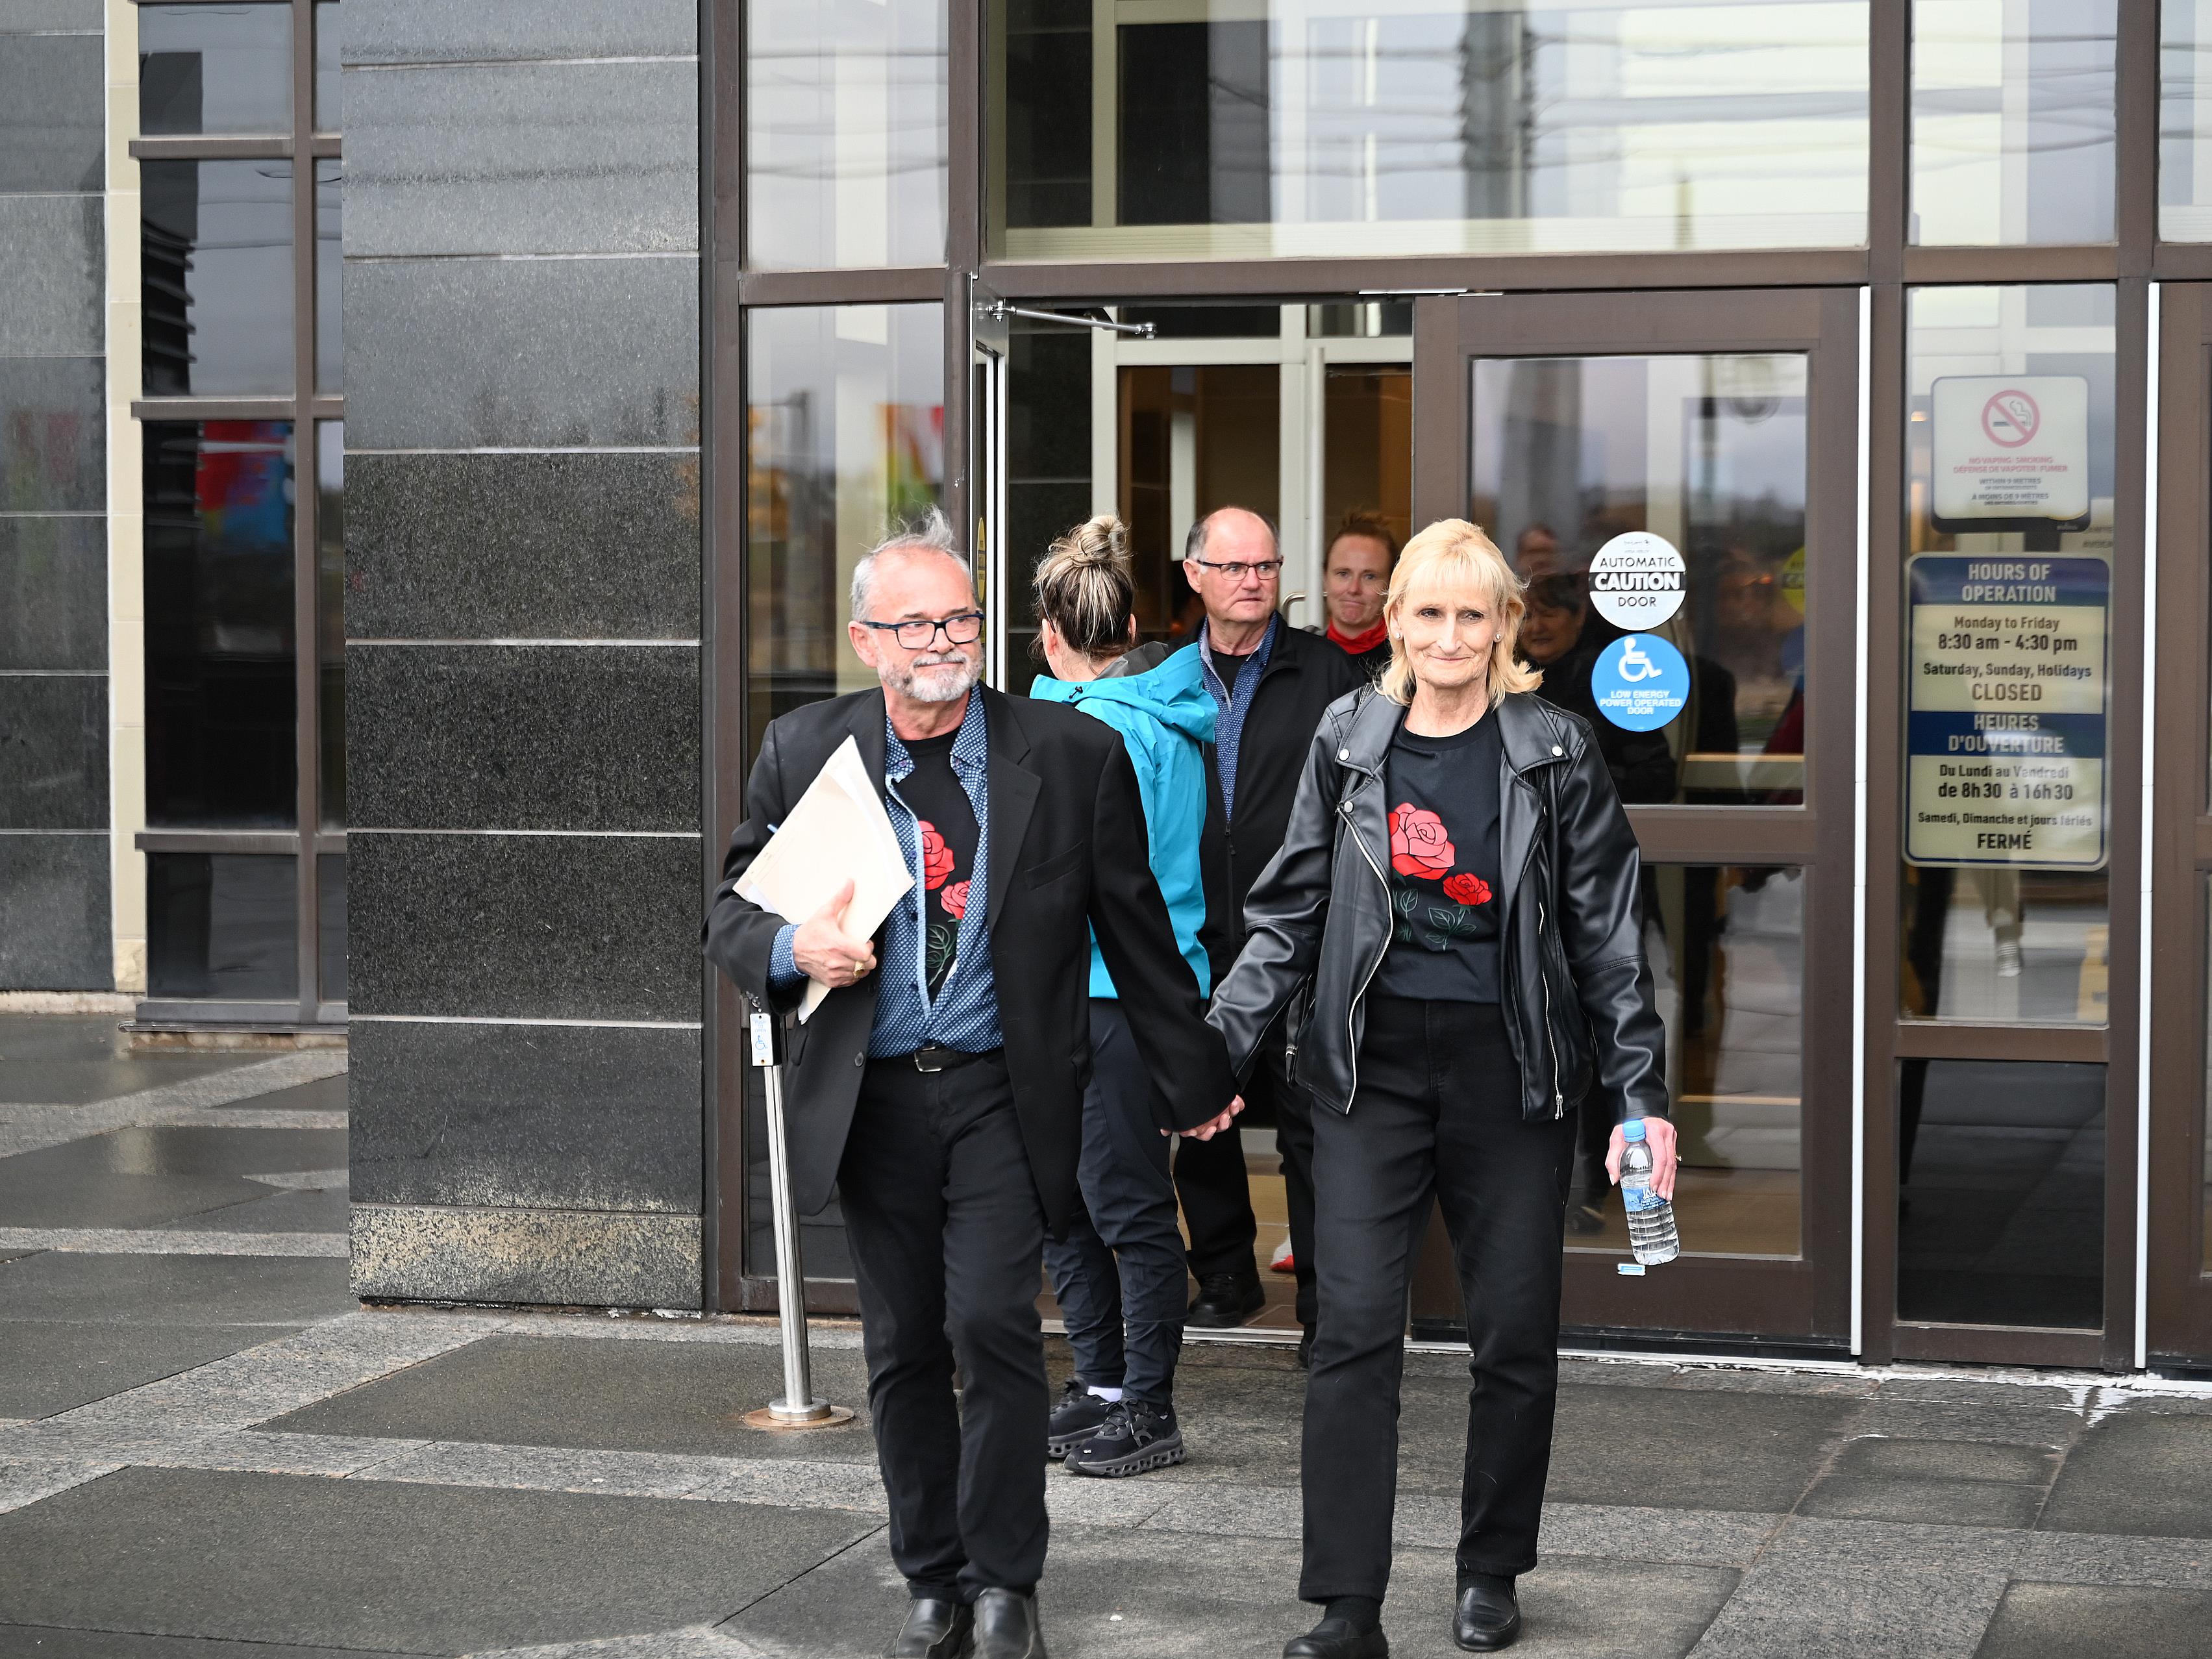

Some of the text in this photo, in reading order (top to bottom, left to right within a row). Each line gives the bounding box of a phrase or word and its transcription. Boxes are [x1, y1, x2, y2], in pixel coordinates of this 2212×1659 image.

[1600, 557, 1675, 567] AUTOMATIC
[1969, 564, 2051, 581] HOURS OF
[1595, 572, 1680, 591] CAUTION
[1618, 597, 1656, 606] DOOR
[1961, 585, 2057, 603] OPERATION
[1954, 616, 2060, 632] Monday to Friday
[1938, 634, 1972, 650] 8:30
[1975, 638, 2000, 650] am
[2015, 634, 2049, 650] 4:30
[2053, 638, 2078, 655] pm
[1923, 662, 2092, 680] Saturday, Sunday, Holidays
[1632, 690, 1671, 699] ENERGY
[1972, 683, 2042, 702] CLOSED
[1627, 706, 1654, 715] DOOR
[1634, 699, 1682, 707] OPERATED
[1973, 714, 2039, 731] HEURES
[1948, 735, 2065, 754] D'OUVERTURE
[1939, 764, 2069, 779] Du Lundi au Vendredi
[1938, 782, 1957, 797] de
[2009, 783, 2019, 799] à
[1917, 812, 1960, 825] Samedi,
[1963, 813, 2015, 825] Dimanche
[2017, 814, 2028, 825] et
[2030, 814, 2057, 828] jours
[1978, 830, 2032, 850] FERMÉ
